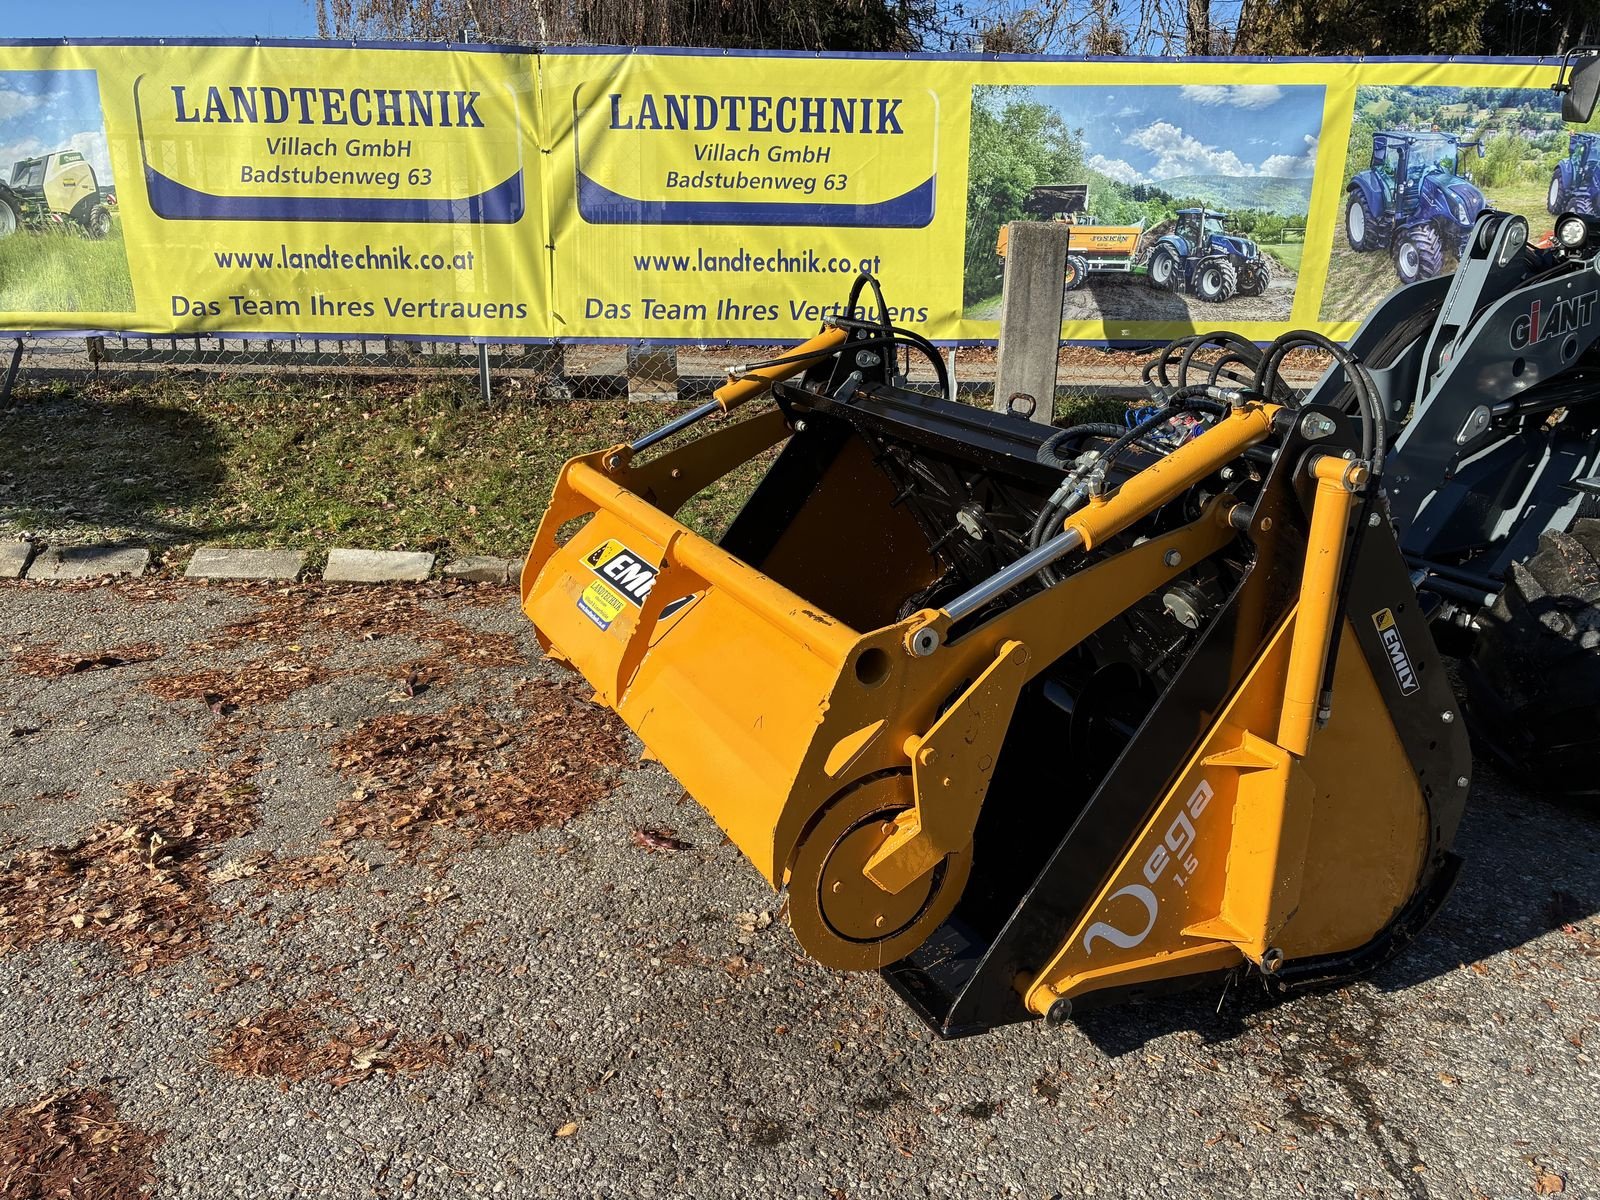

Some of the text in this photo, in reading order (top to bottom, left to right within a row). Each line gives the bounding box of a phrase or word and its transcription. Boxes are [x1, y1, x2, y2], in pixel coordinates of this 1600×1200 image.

[171, 85, 485, 128] LANDTECHNIK
[608, 93, 904, 135] LANDTECHNIK
[266, 137, 412, 157] Villach GmbH
[694, 143, 831, 163] Villach GmbH
[241, 165, 432, 189] Badstubenweg 63
[666, 170, 848, 194] Badstubenweg 63
[214, 244, 474, 270] www.landtechnik.co.at
[633, 247, 880, 274] www.landtechnik.co.at
[171, 295, 527, 319] Das Team Ihres Vertrauens
[585, 298, 631, 319] Das
[641, 299, 707, 320] Team
[717, 298, 779, 321] Ihres
[1383, 628, 1416, 689] EMILY
[1173, 853, 1199, 888] 1.5
